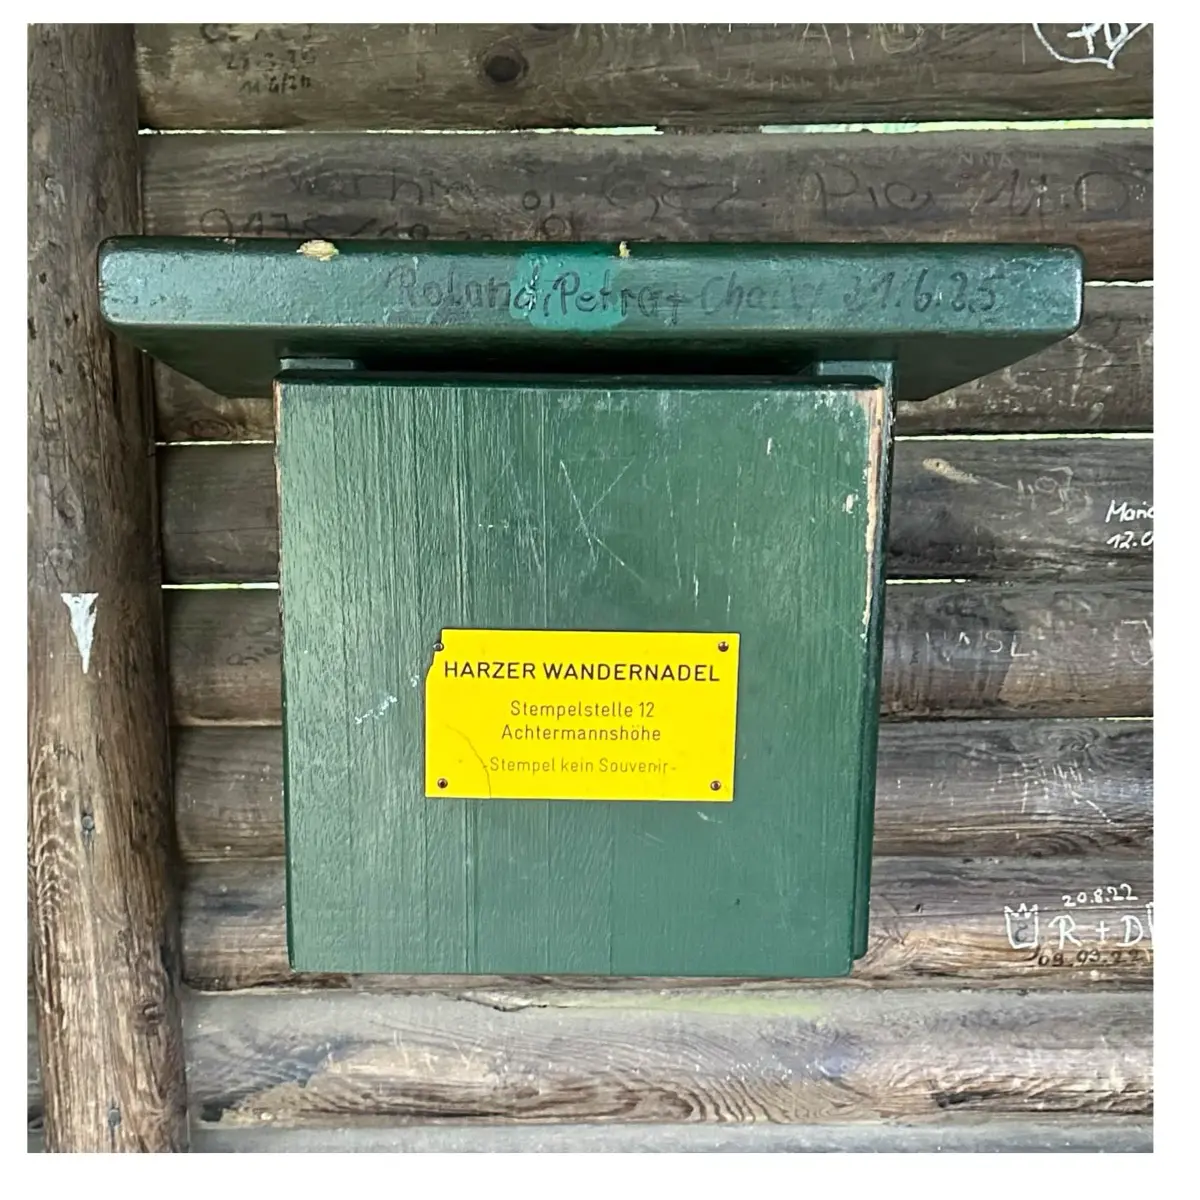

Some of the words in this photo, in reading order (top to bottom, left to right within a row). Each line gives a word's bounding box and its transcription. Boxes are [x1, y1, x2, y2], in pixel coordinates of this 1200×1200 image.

[444, 661, 536, 679] HARZER
[543, 662, 720, 681] WANDERNADEL
[510, 700, 634, 720] Stempelstelle
[638, 702, 655, 718] 12
[501, 724, 661, 741] Achtermannshöhe
[561, 757, 594, 773] kein
[1061, 883, 1138, 907] 20.8.22
[1048, 915, 1082, 949] R
[1117, 915, 1144, 946] D
